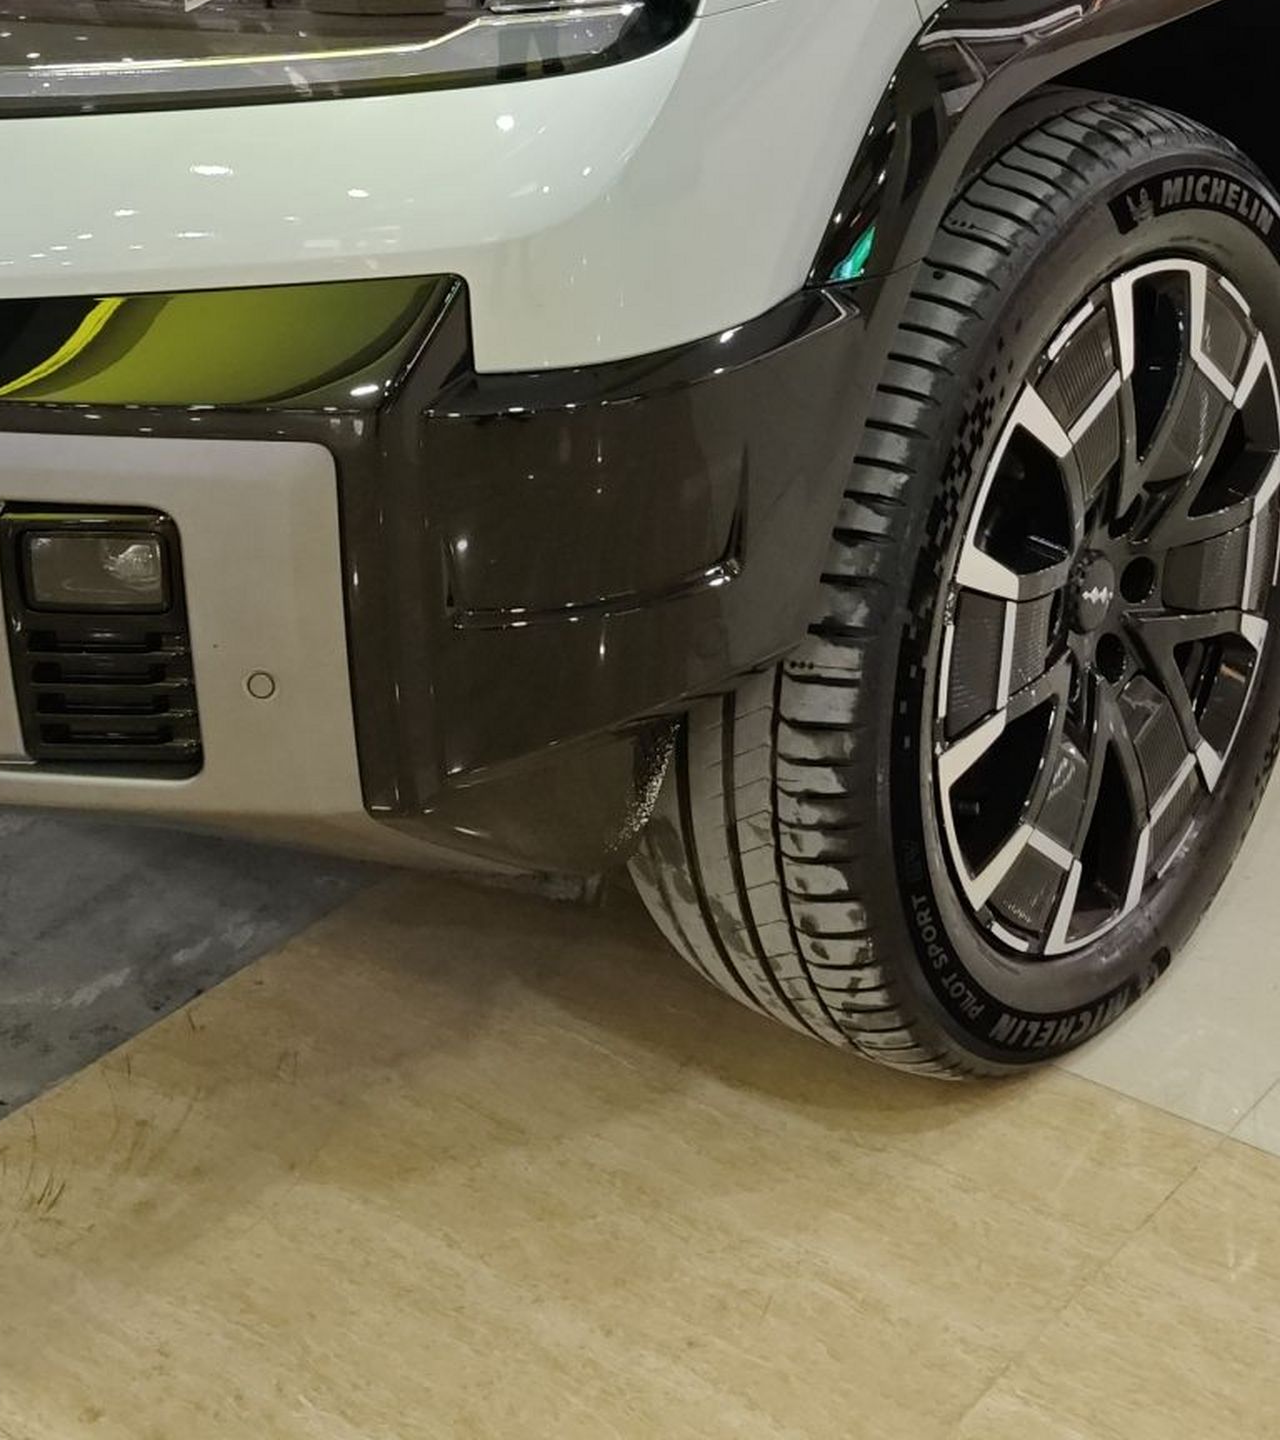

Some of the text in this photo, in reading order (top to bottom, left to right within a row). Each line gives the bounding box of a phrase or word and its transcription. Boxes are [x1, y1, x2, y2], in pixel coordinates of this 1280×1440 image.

[1160, 174, 1275, 235] MICHELIN
[911, 893, 1129, 1047] MICHELIN PILOT SPORT
